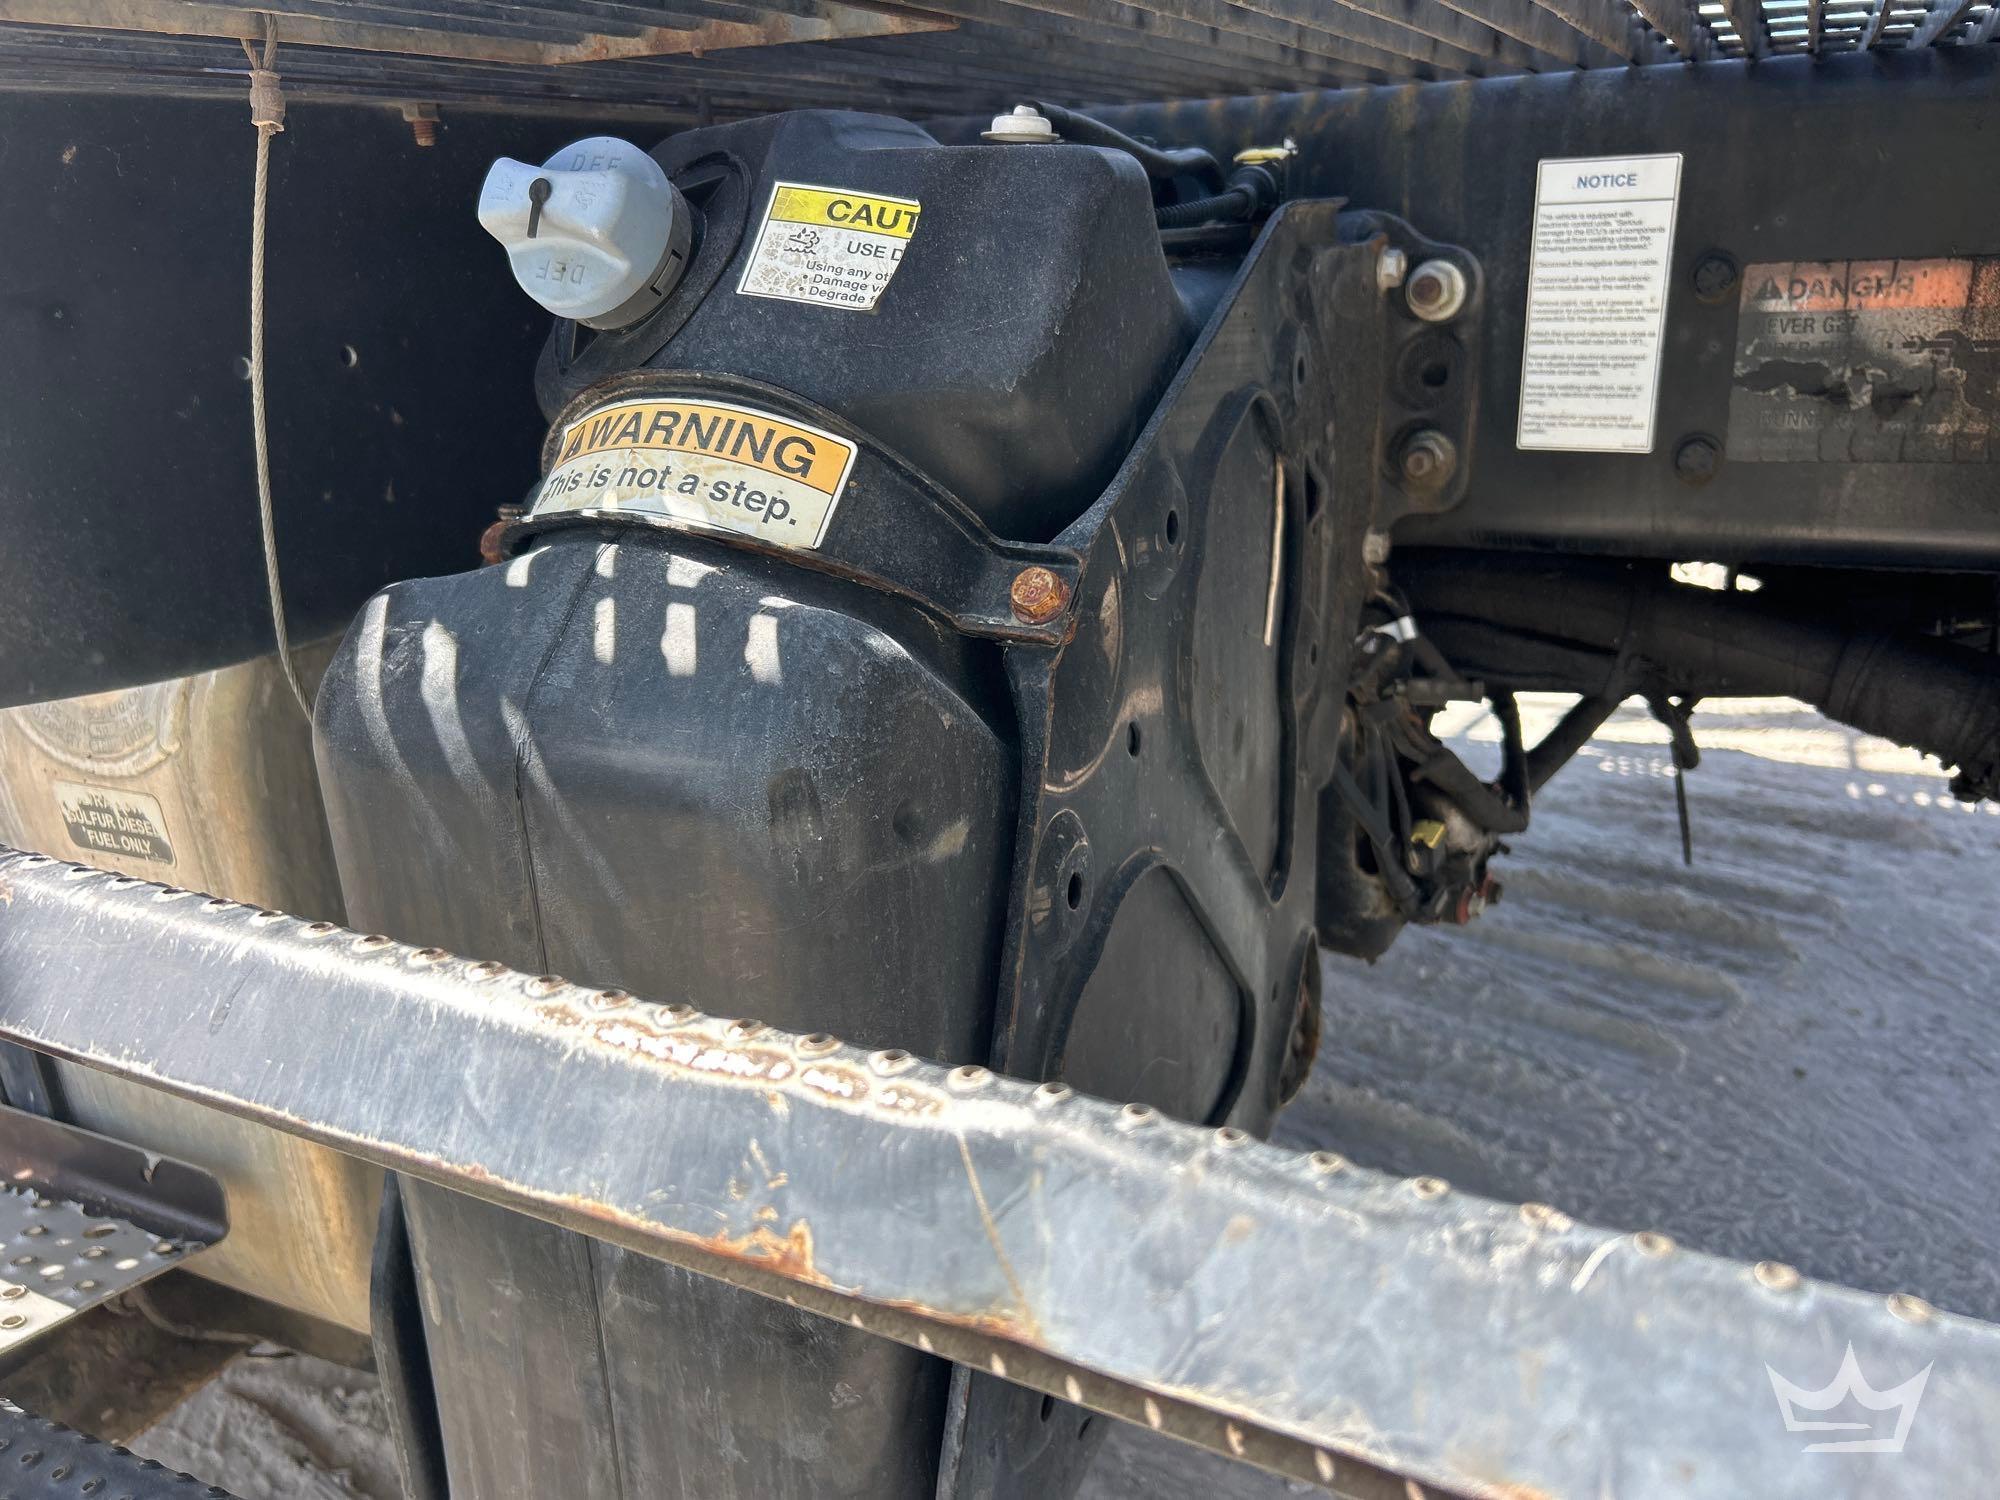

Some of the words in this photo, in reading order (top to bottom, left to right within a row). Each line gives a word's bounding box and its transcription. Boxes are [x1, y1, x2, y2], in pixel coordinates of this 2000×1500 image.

[1576, 174, 1638, 189] NOTICE
[846, 241, 887, 259] USE
[806, 260, 844, 276] Using
[847, 268, 872, 281] any
[812, 274, 868, 293] Damage
[809, 286, 866, 304] Degrade
[588, 410, 817, 479] WARNING
[548, 468, 583, 499] This
[586, 463, 612, 489] is
[616, 464, 673, 490] not
[678, 473, 700, 496] a
[708, 479, 798, 526] step.
[86, 828, 120, 848] FUEL
[120, 835, 151, 855] ONLY
